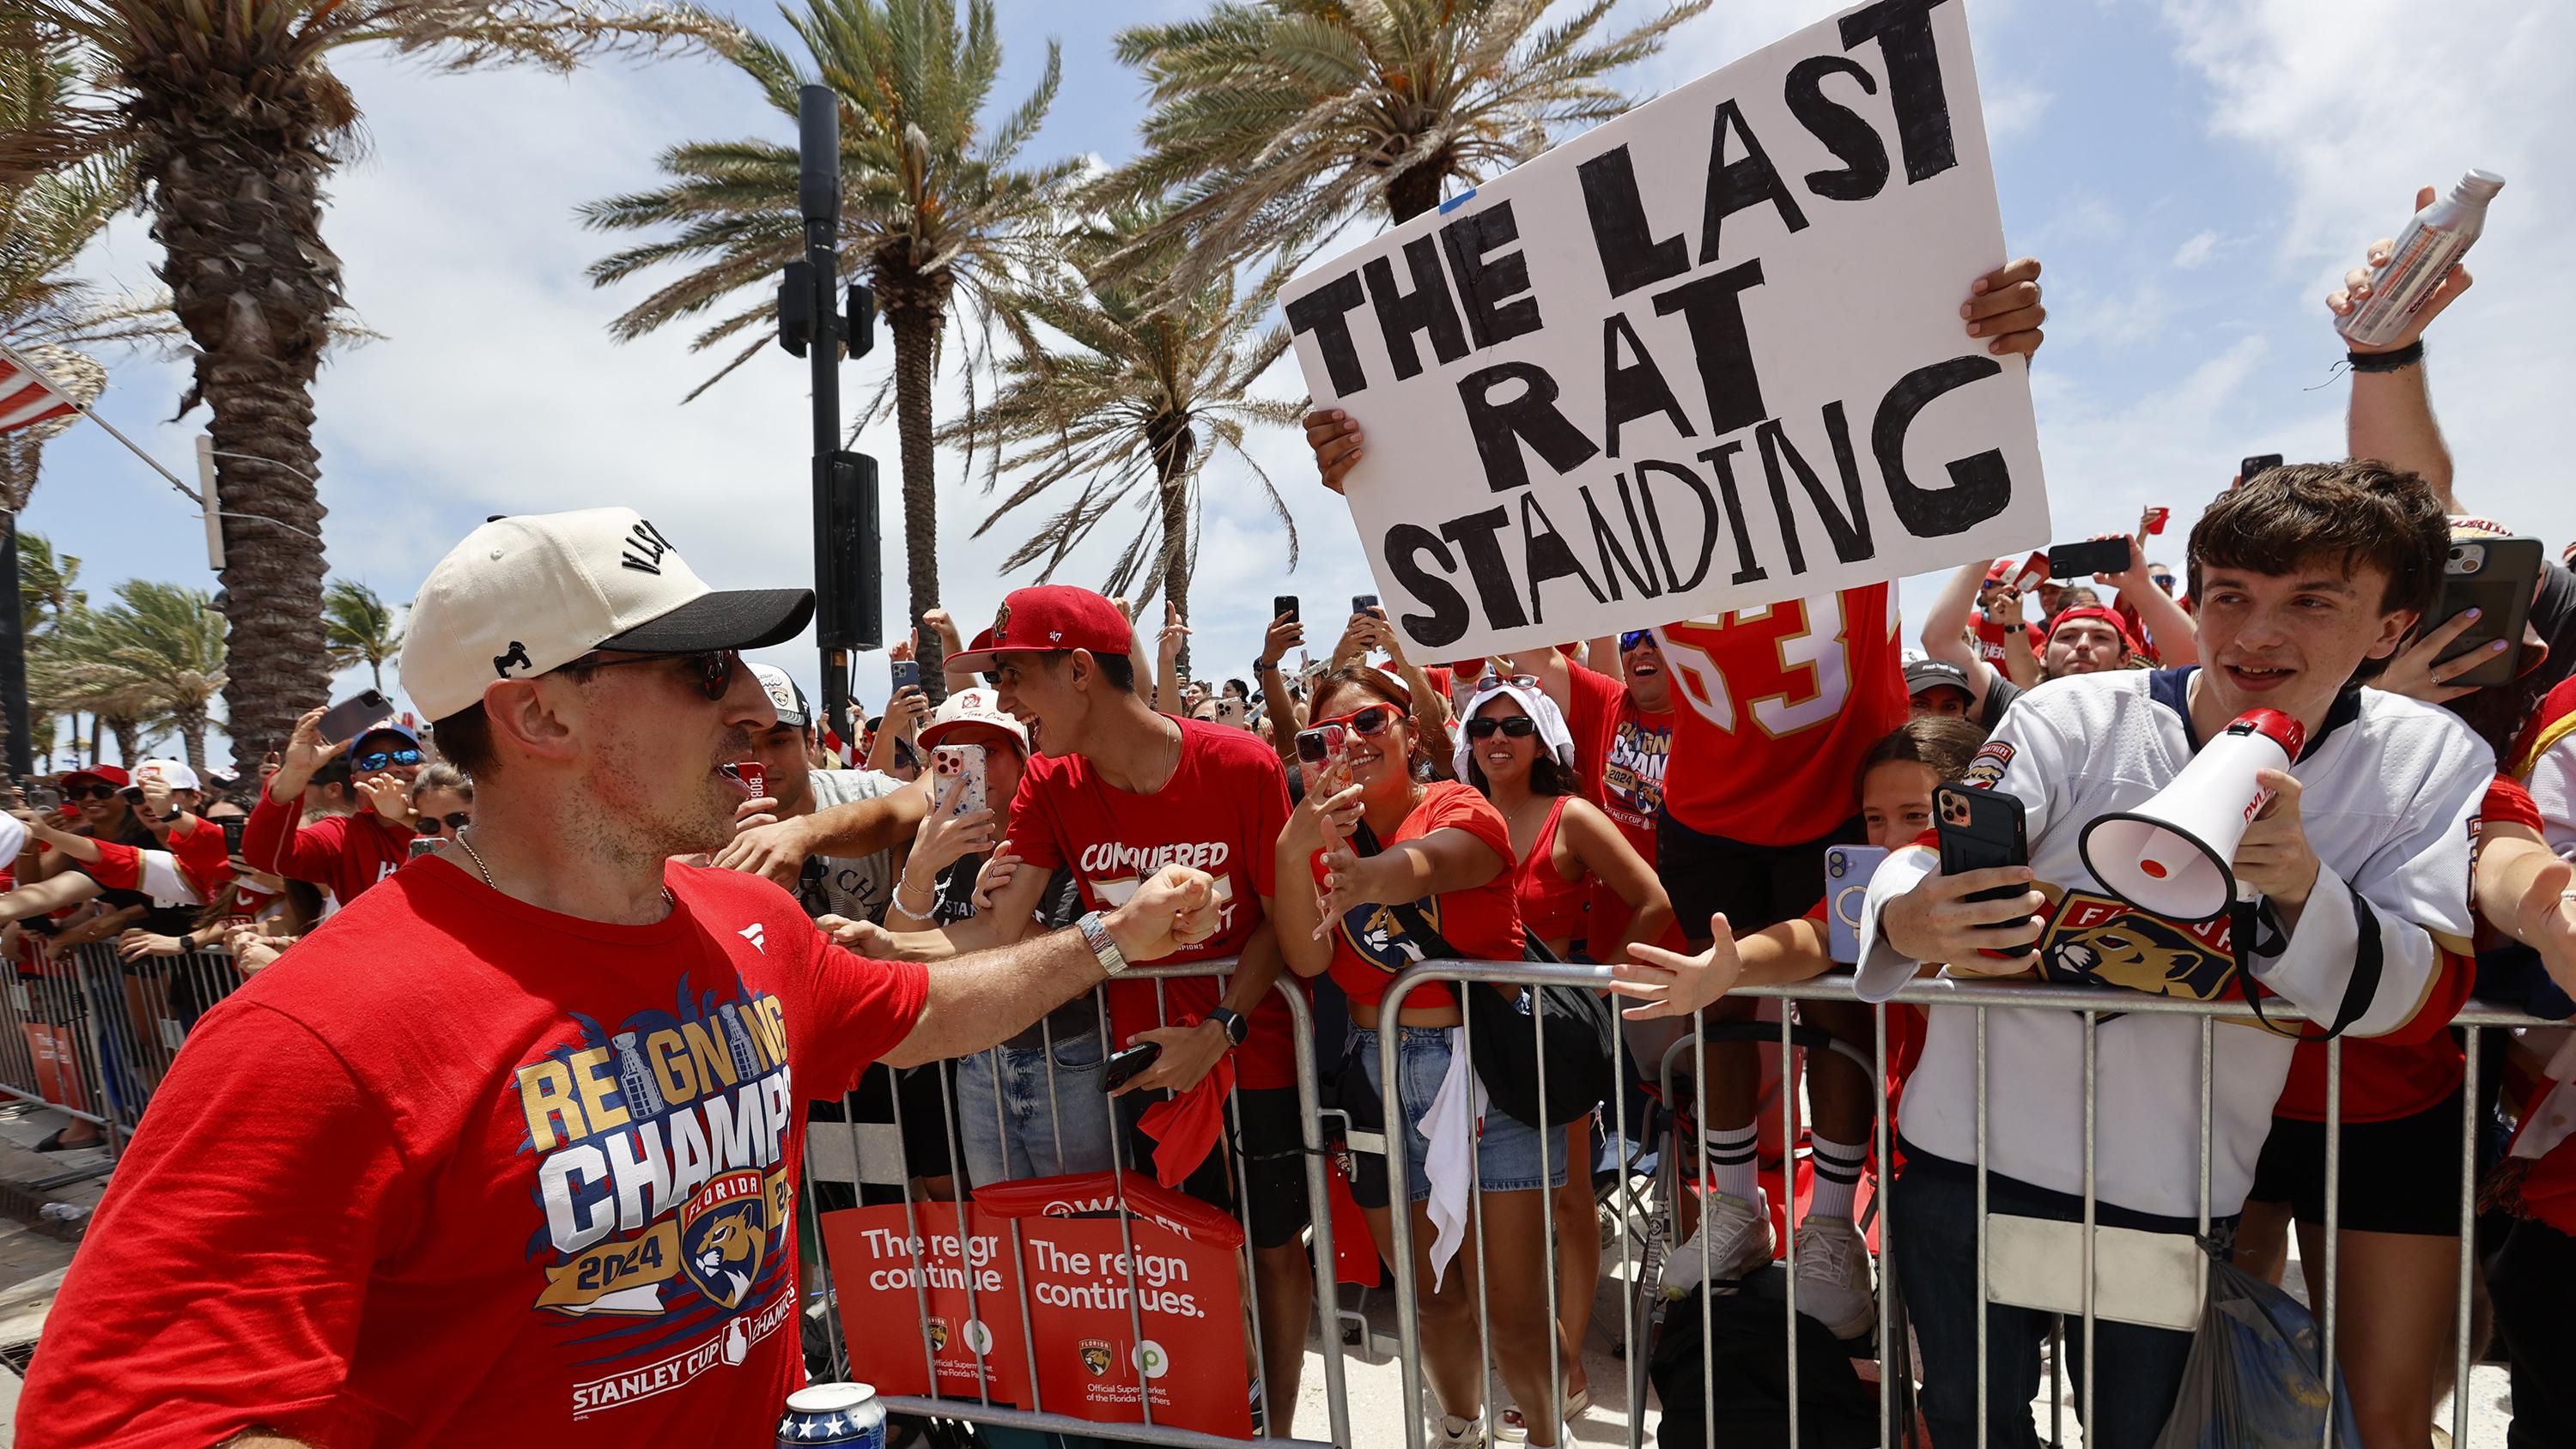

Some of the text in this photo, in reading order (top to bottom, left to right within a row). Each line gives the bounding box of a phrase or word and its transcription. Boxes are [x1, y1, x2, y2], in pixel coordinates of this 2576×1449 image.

[1285, 0, 1958, 398] THE LAST
[1455, 257, 1771, 494] RAT
[1383, 354, 2012, 648] STANDING
[1608, 769, 1632, 786] 2024
[1628, 815, 1643, 824] CUP
[1080, 841, 1230, 874] CONQUERED
[688, 1176, 758, 1223] FLORIDA
[860, 1228, 925, 1259] The
[1029, 1239, 1189, 1288] The reign
[576, 1239, 665, 1290] 2024
[869, 1258, 1004, 1292] continue
[573, 1361, 682, 1410] STANLEY
[687, 1342, 720, 1375] CUP
[1087, 1383, 1167, 1396] Official Superarket
[1109, 1394, 1137, 1403] Florida
[1138, 1395, 1171, 1406] Pnthers
